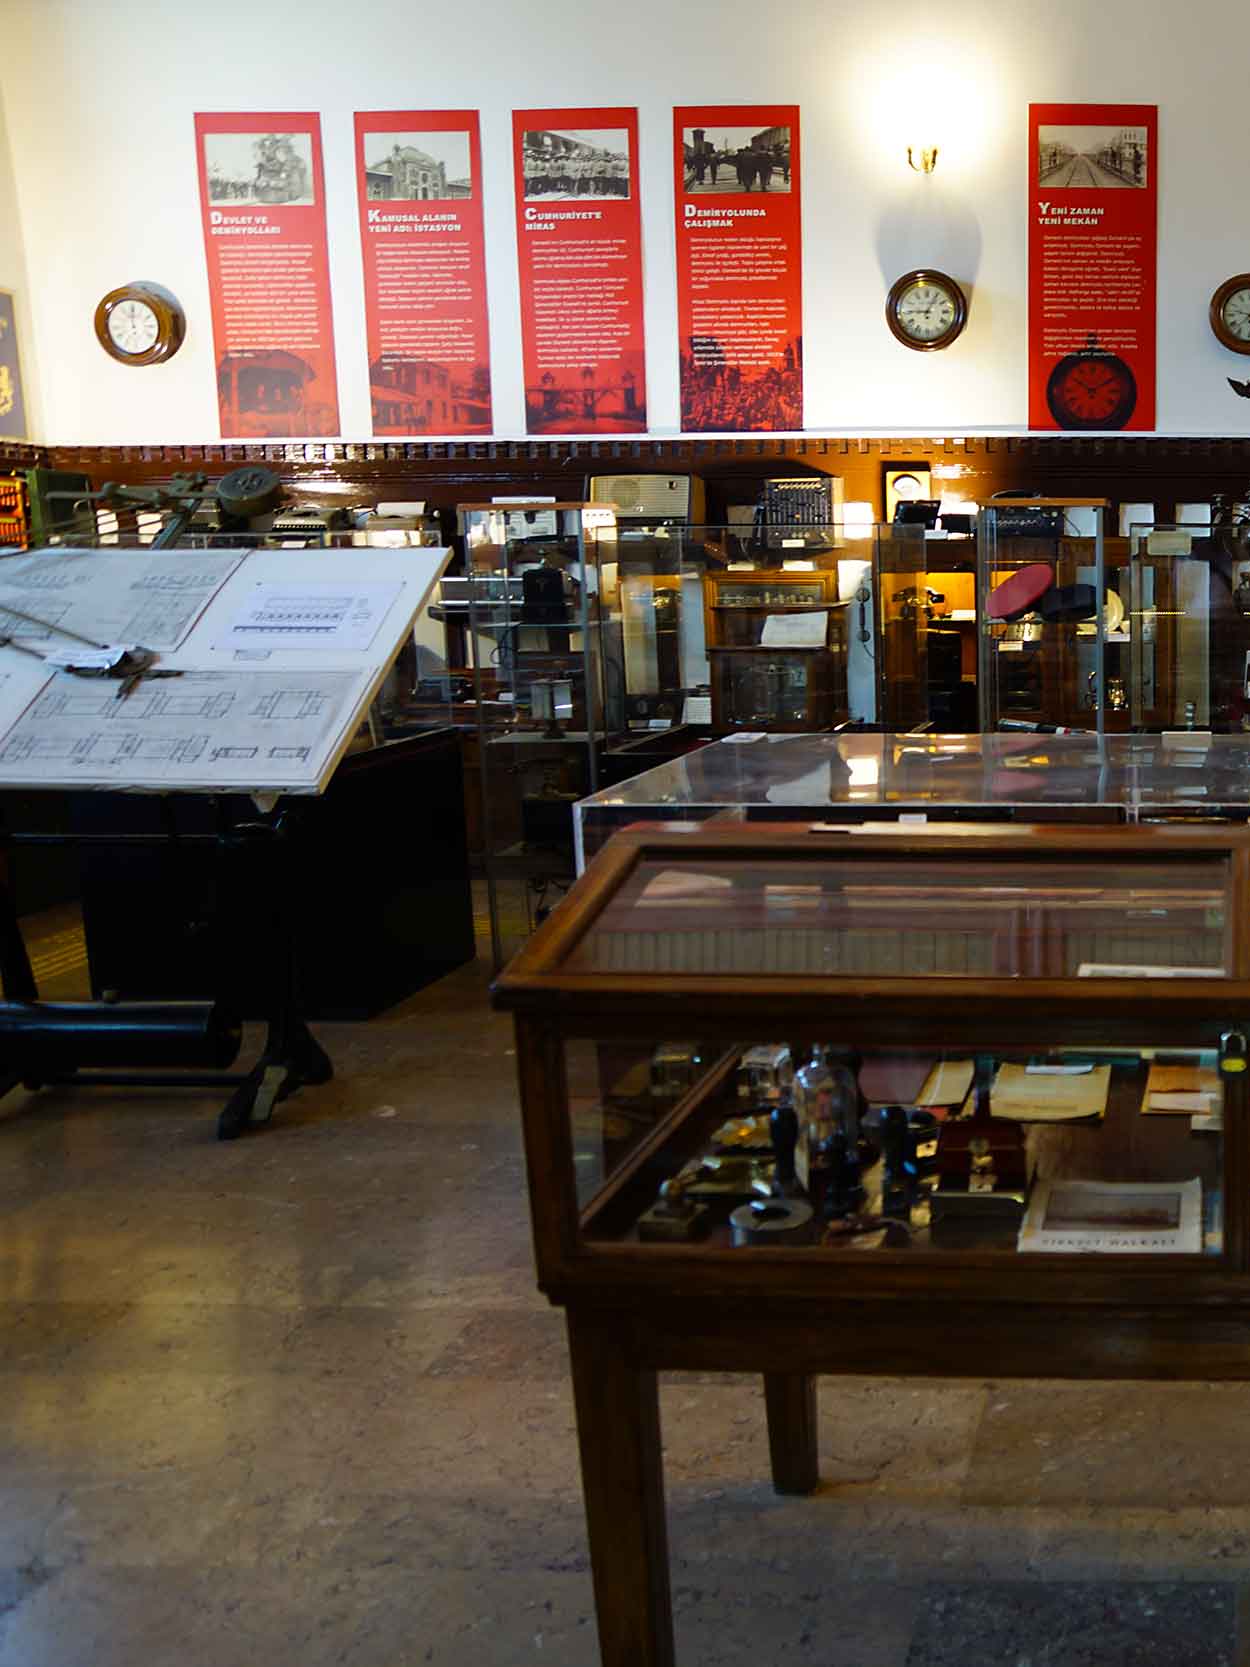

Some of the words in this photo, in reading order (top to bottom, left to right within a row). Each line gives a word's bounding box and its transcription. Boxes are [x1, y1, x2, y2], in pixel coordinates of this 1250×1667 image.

[684, 203, 767, 217] DEMİRYOLUNDA
[1037, 201, 1068, 215] YENİ
[1070, 207, 1104, 215] ZAMAN
[209, 210, 253, 225] DEVLET
[367, 208, 420, 222] KAMUSAL
[1037, 216, 1061, 225] YENİ
[367, 223, 391, 233] YENİ
[414, 222, 462, 233] İSTASYON
[524, 221, 556, 232] MİRAS
[683, 218, 734, 229] ÇALIŞMAK
